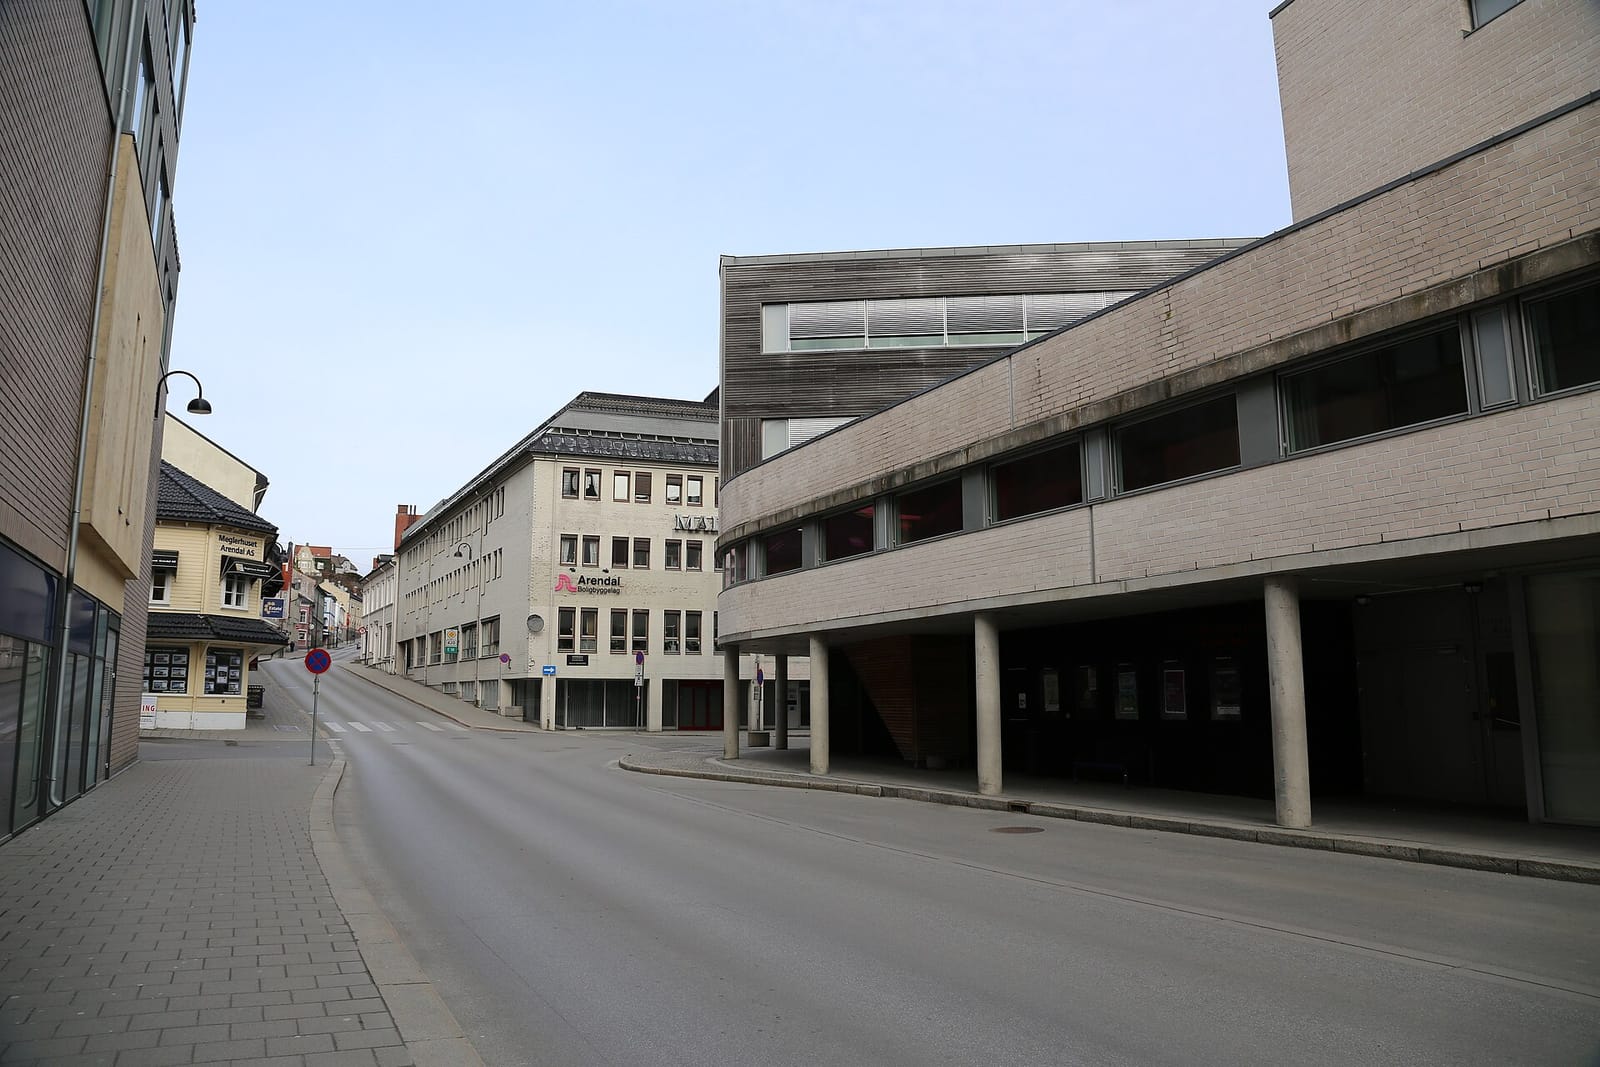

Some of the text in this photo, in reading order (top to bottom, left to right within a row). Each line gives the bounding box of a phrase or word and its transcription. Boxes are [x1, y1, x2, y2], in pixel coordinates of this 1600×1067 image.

[219, 535, 257, 547] Meglerhuset
[221, 545, 246, 555] Arendal
[578, 575, 620, 586] Arendal
[578, 586, 620, 595] Boligbyggelag
